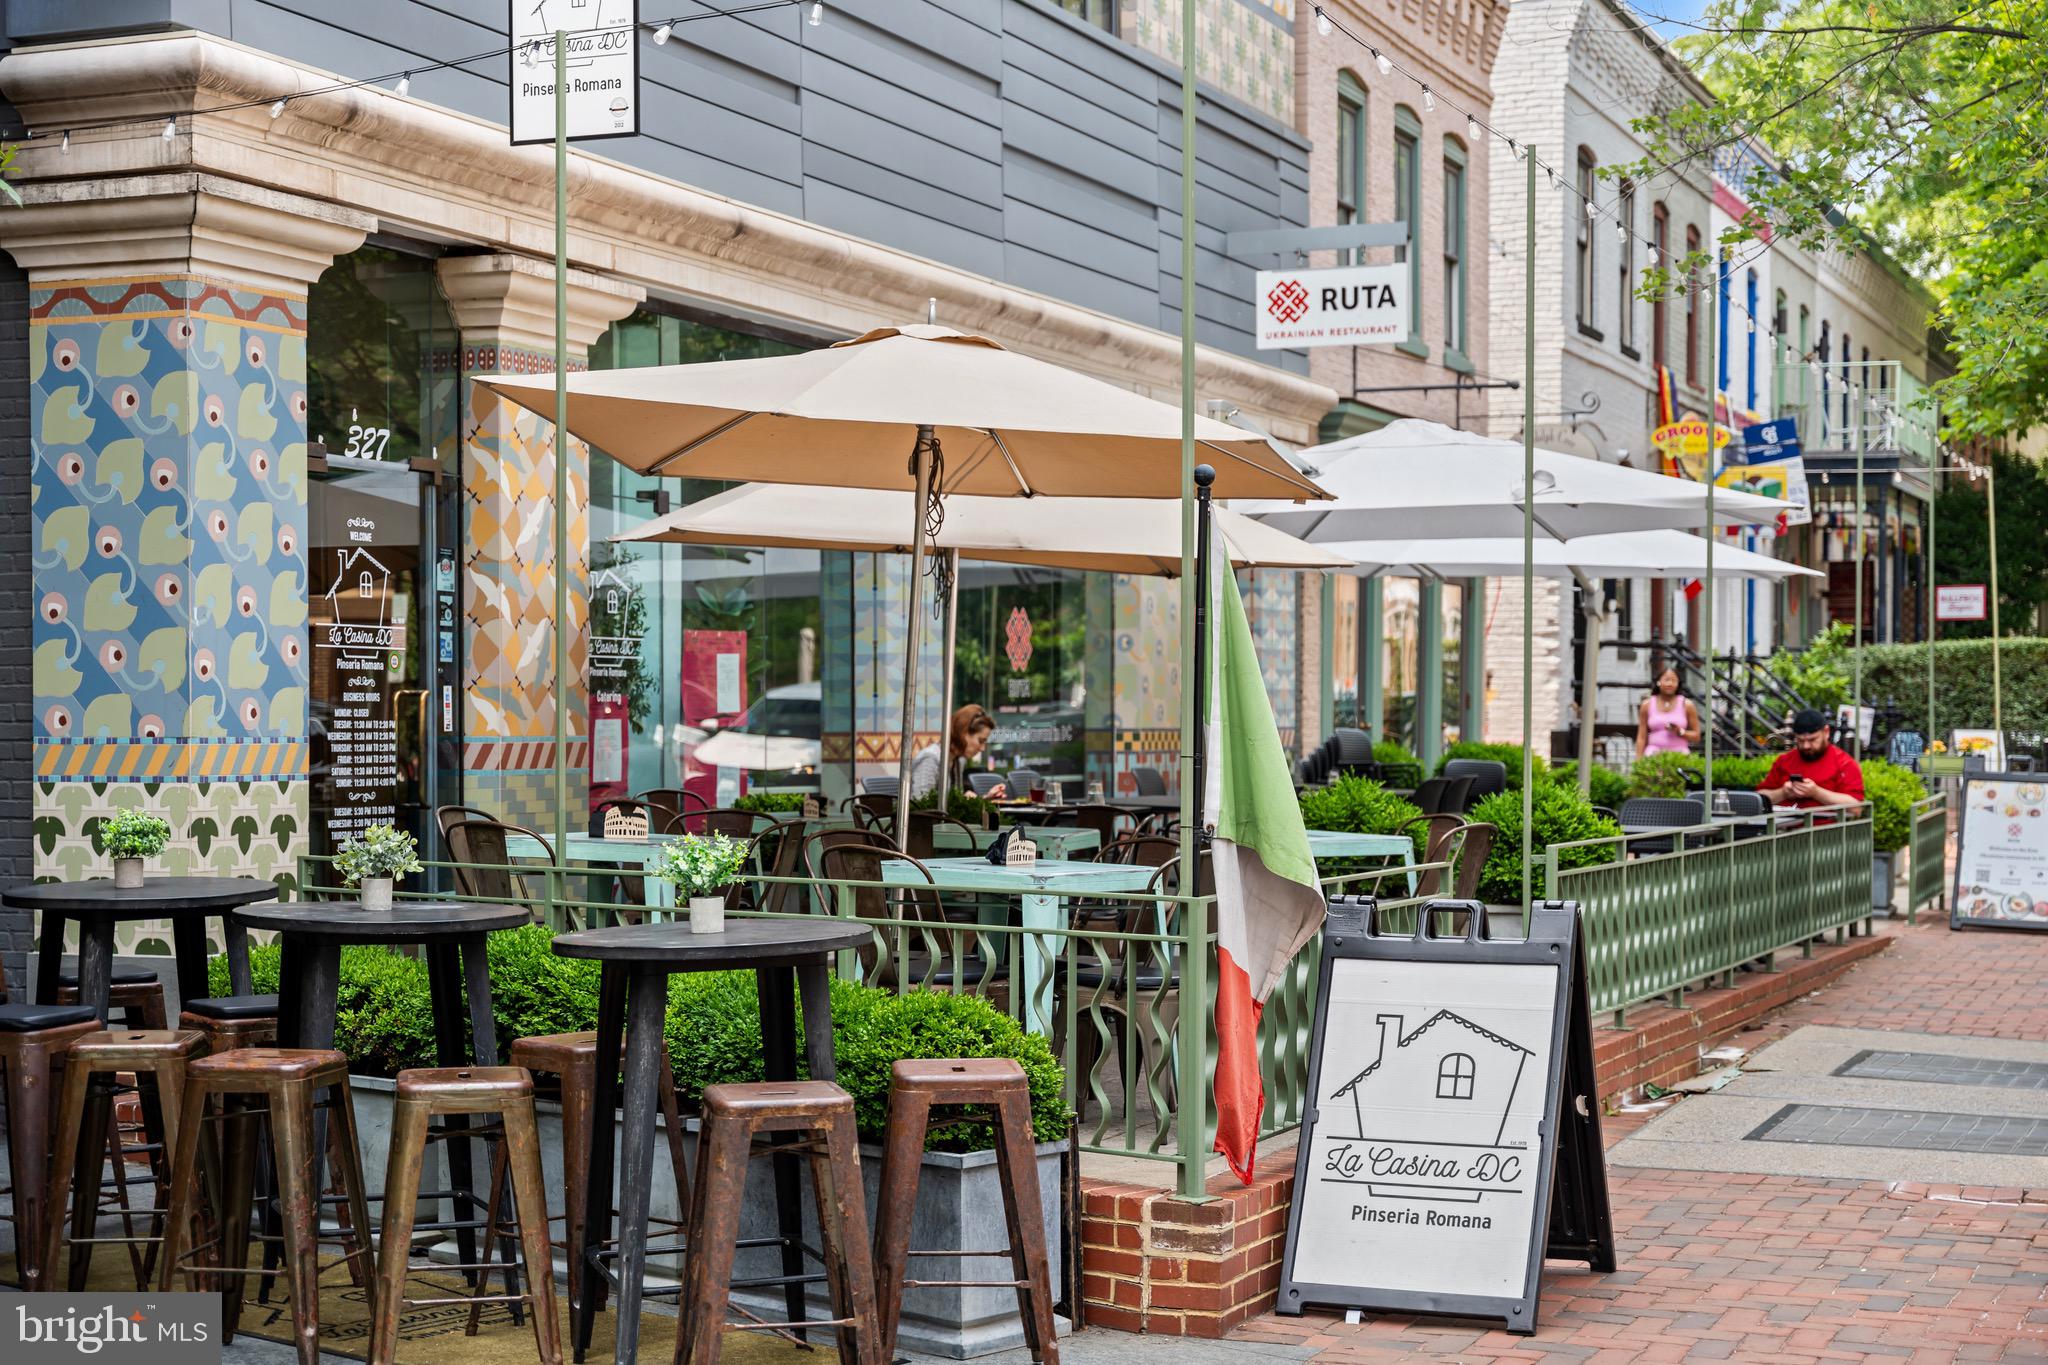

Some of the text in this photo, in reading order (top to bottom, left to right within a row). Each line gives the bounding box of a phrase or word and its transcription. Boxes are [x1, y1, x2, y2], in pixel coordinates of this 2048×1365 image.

[598, 31, 628, 51] DC
[574, 78, 622, 93] Romana
[1322, 284, 1397, 312] RUTA
[1265, 325, 1398, 340] UKRAINIAN RESTAURANT
[1656, 425, 1727, 443] GROOY
[344, 425, 390, 461] 327
[350, 531, 372, 542] WELCOME
[329, 626, 392, 646] La Casina DC
[595, 639, 618, 654] Casina
[620, 640, 634, 655] DC
[336, 658, 360, 669] Pinseria
[361, 659, 384, 670] Romana
[590, 667, 627, 678] Pinseria Romana
[343, 692, 380, 702] BUSINESS HOURS
[596, 690, 621, 705] Catering
[334, 708, 369, 717] MONDAY: CLOSED
[334, 720, 352, 728] TUESDAY:
[354, 720, 365, 728] 11:30
[354, 732, 365, 740] 11:30
[354, 744, 365, 752] 11:30
[354, 755, 365, 763] 11:30
[354, 767, 365, 775] 11:30
[354, 779, 365, 787] 11:30
[334, 807, 353, 816] TUESDAY:
[354, 806, 363, 815] 5:30
[1326, 1144, 1522, 1182] La Casina DC
[1352, 1205, 1492, 1230] Pinseria Romana
